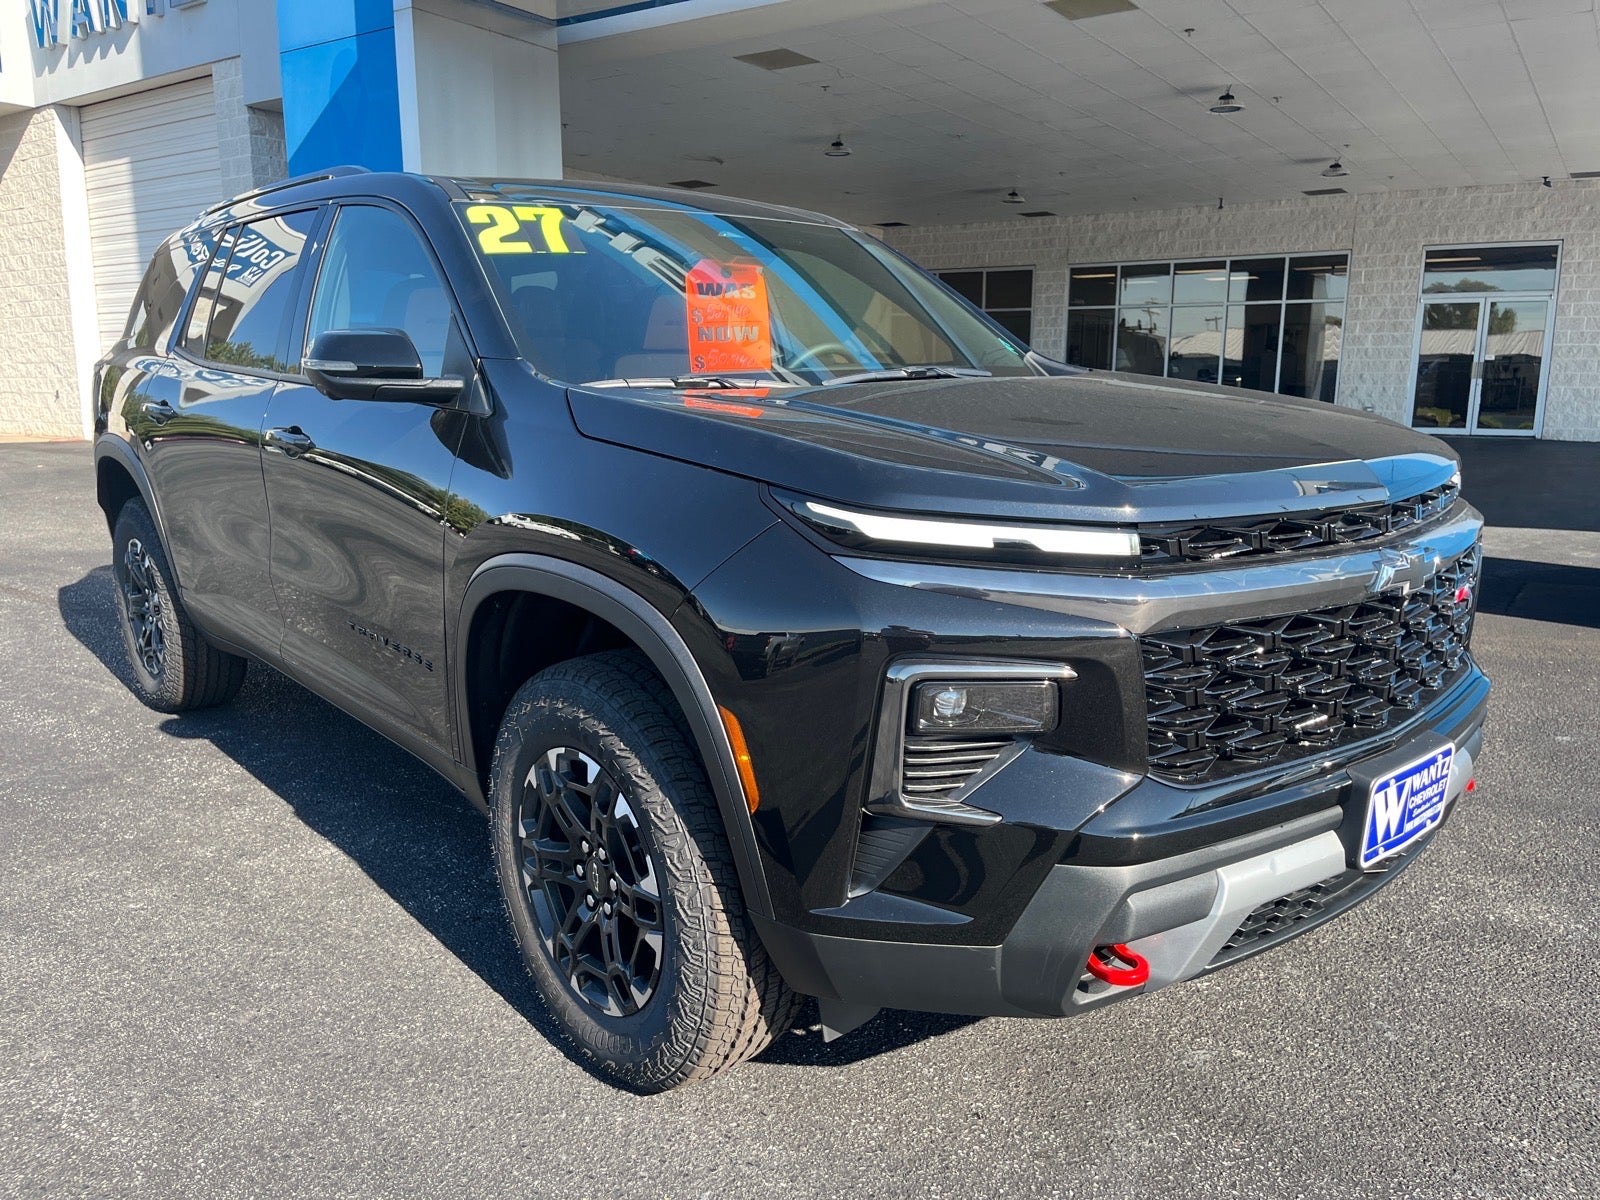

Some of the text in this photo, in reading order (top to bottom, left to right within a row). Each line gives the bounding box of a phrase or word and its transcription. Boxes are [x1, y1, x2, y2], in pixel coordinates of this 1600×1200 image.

[466, 205, 567, 254] 27
[696, 281, 757, 299] WAS
[697, 326, 760, 342] NOW
[1412, 756, 1451, 792] WANTZ
[1409, 778, 1447, 809] CHEVROLET
[1374, 779, 1412, 845] W
